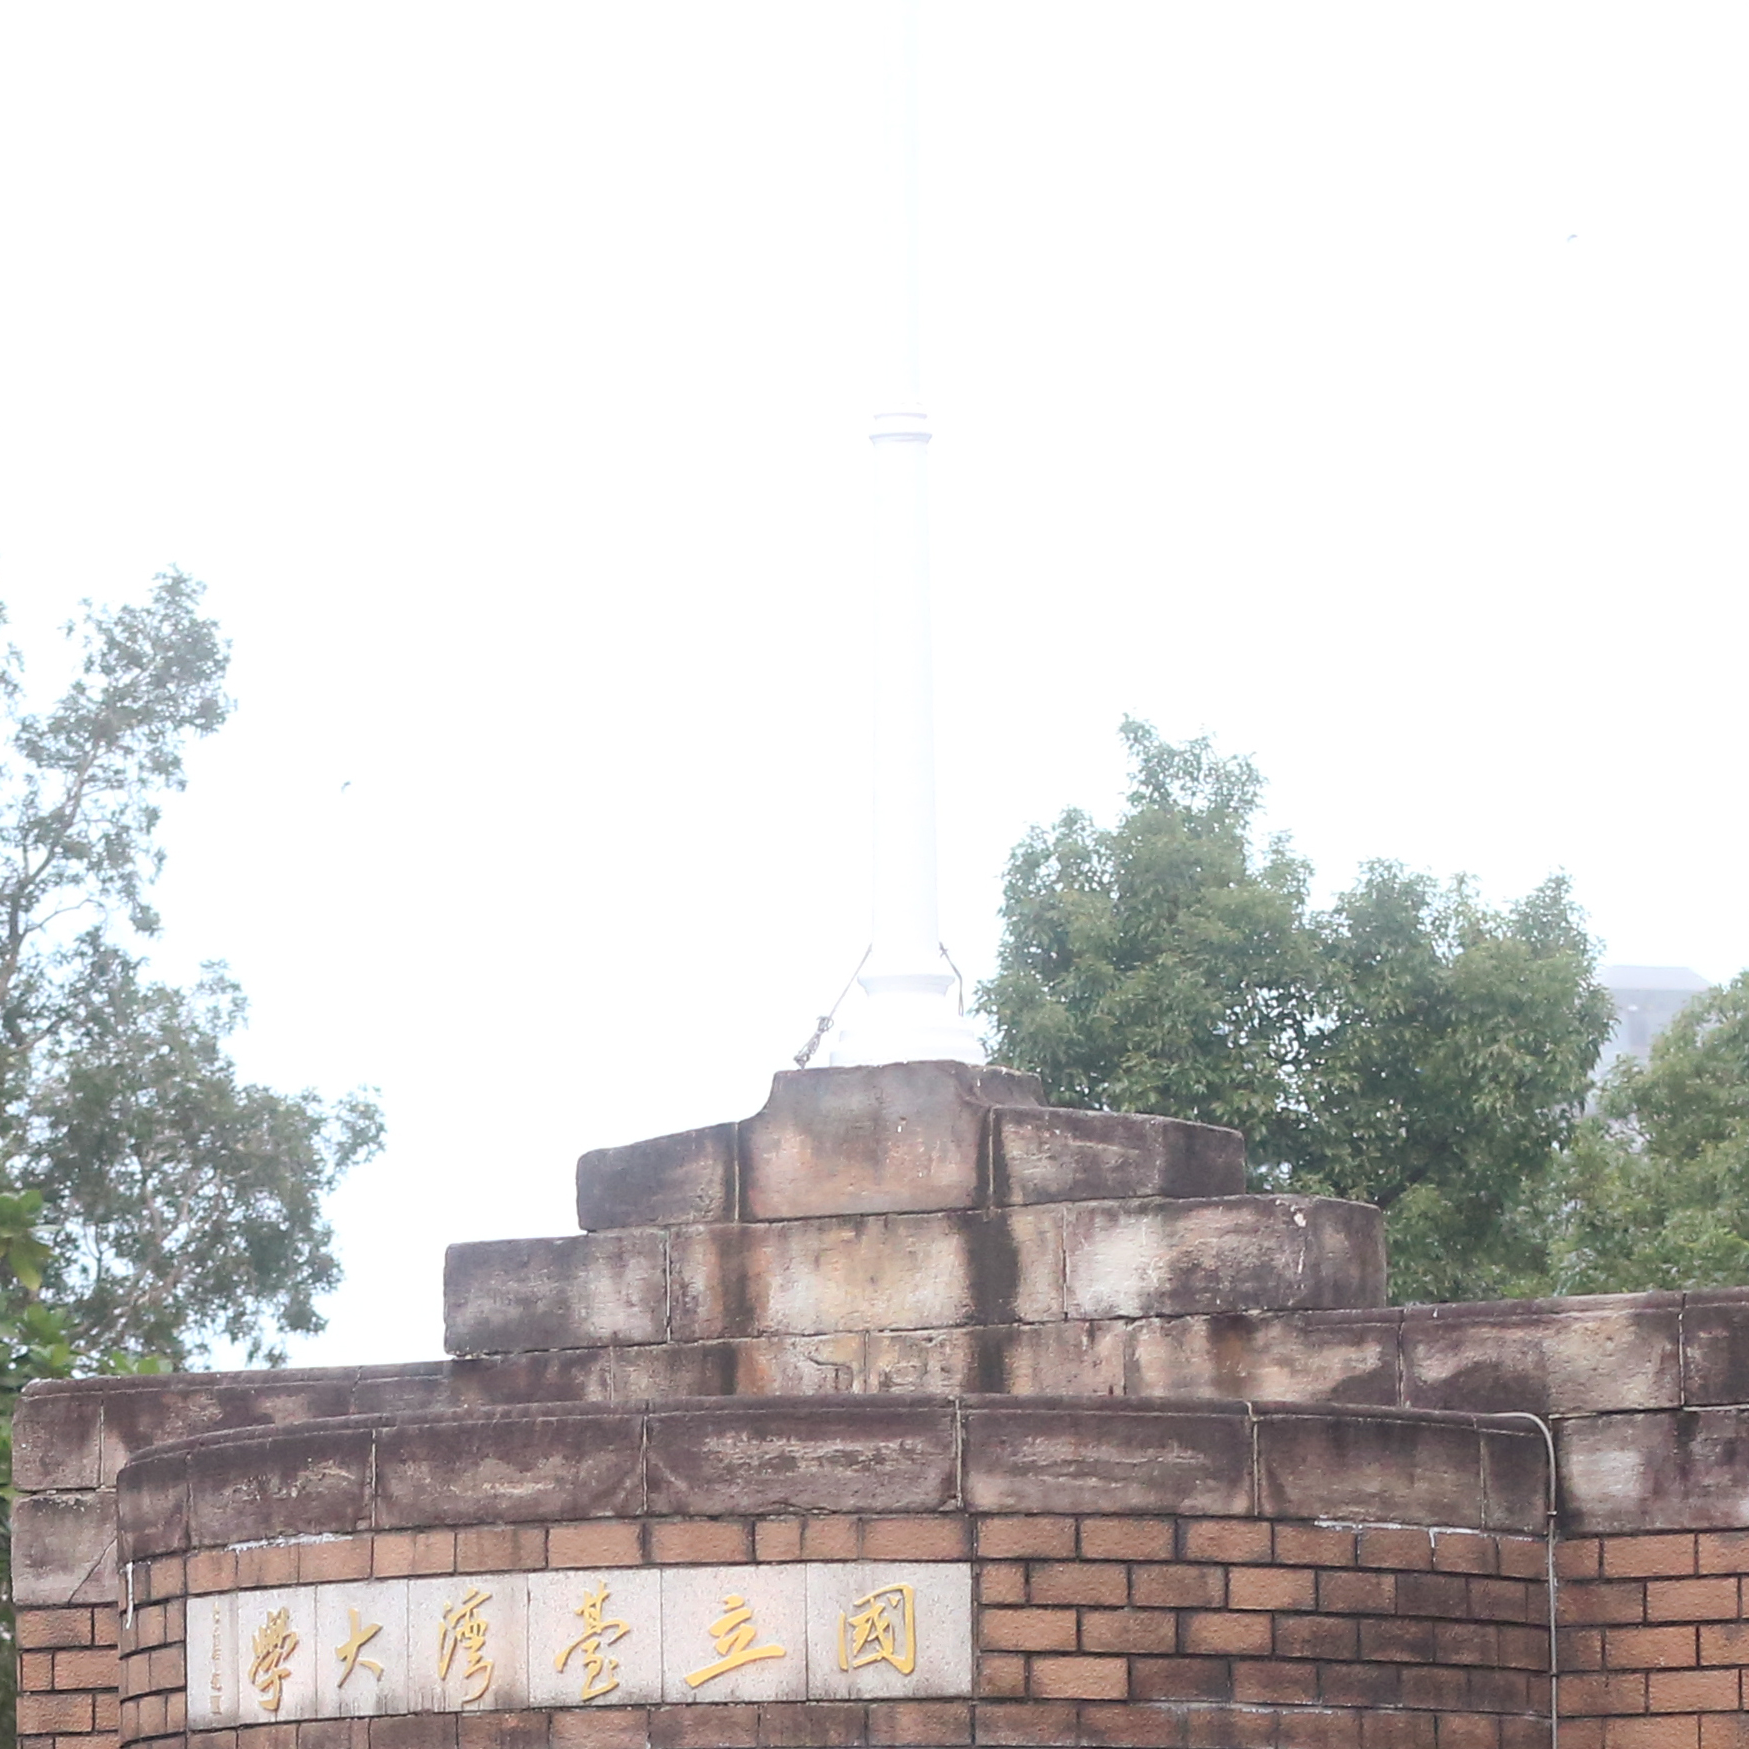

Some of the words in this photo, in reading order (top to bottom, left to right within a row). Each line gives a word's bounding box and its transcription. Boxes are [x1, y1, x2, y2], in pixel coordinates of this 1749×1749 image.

[247, 1581, 915, 1711] 國立臺灣大學
